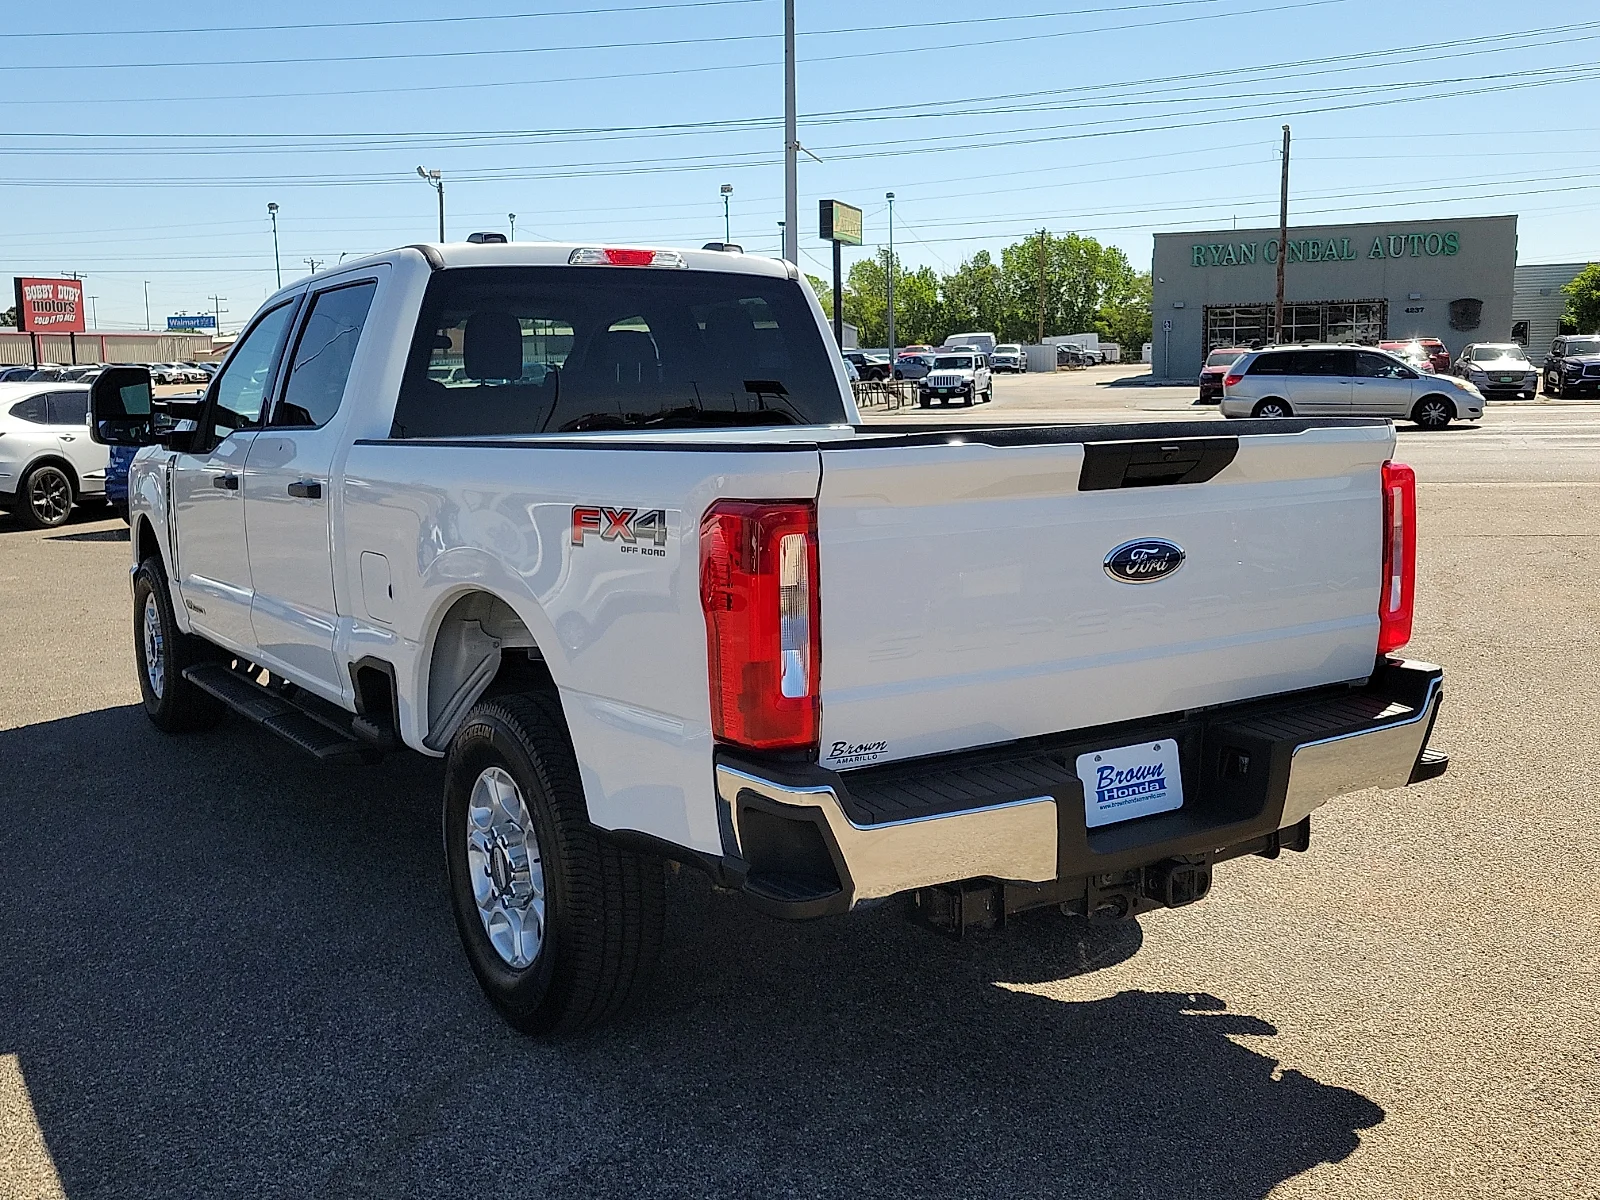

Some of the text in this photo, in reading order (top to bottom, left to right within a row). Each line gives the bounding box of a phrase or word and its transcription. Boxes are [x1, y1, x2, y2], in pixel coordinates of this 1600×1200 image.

[1190, 231, 1461, 267] RYAN ONEAL AUTOS
[24, 284, 80, 303] BOBBY DUBY
[32, 299, 76, 313] motors
[1405, 306, 1425, 314] 4237
[33, 316, 50, 325] SOLD
[49, 315, 56, 324] IT
[56, 314, 64, 323] TO
[169, 318, 199, 327] Walmart
[570, 505, 667, 548] FX4
[620, 545, 666, 557] OFF ROAD
[1125, 547, 1170, 575] Ford
[829, 740, 888, 757] Brown
[836, 753, 878, 765] AMARILLO
[1096, 762, 1164, 790] Brown
[1103, 781, 1160, 801] Honda
